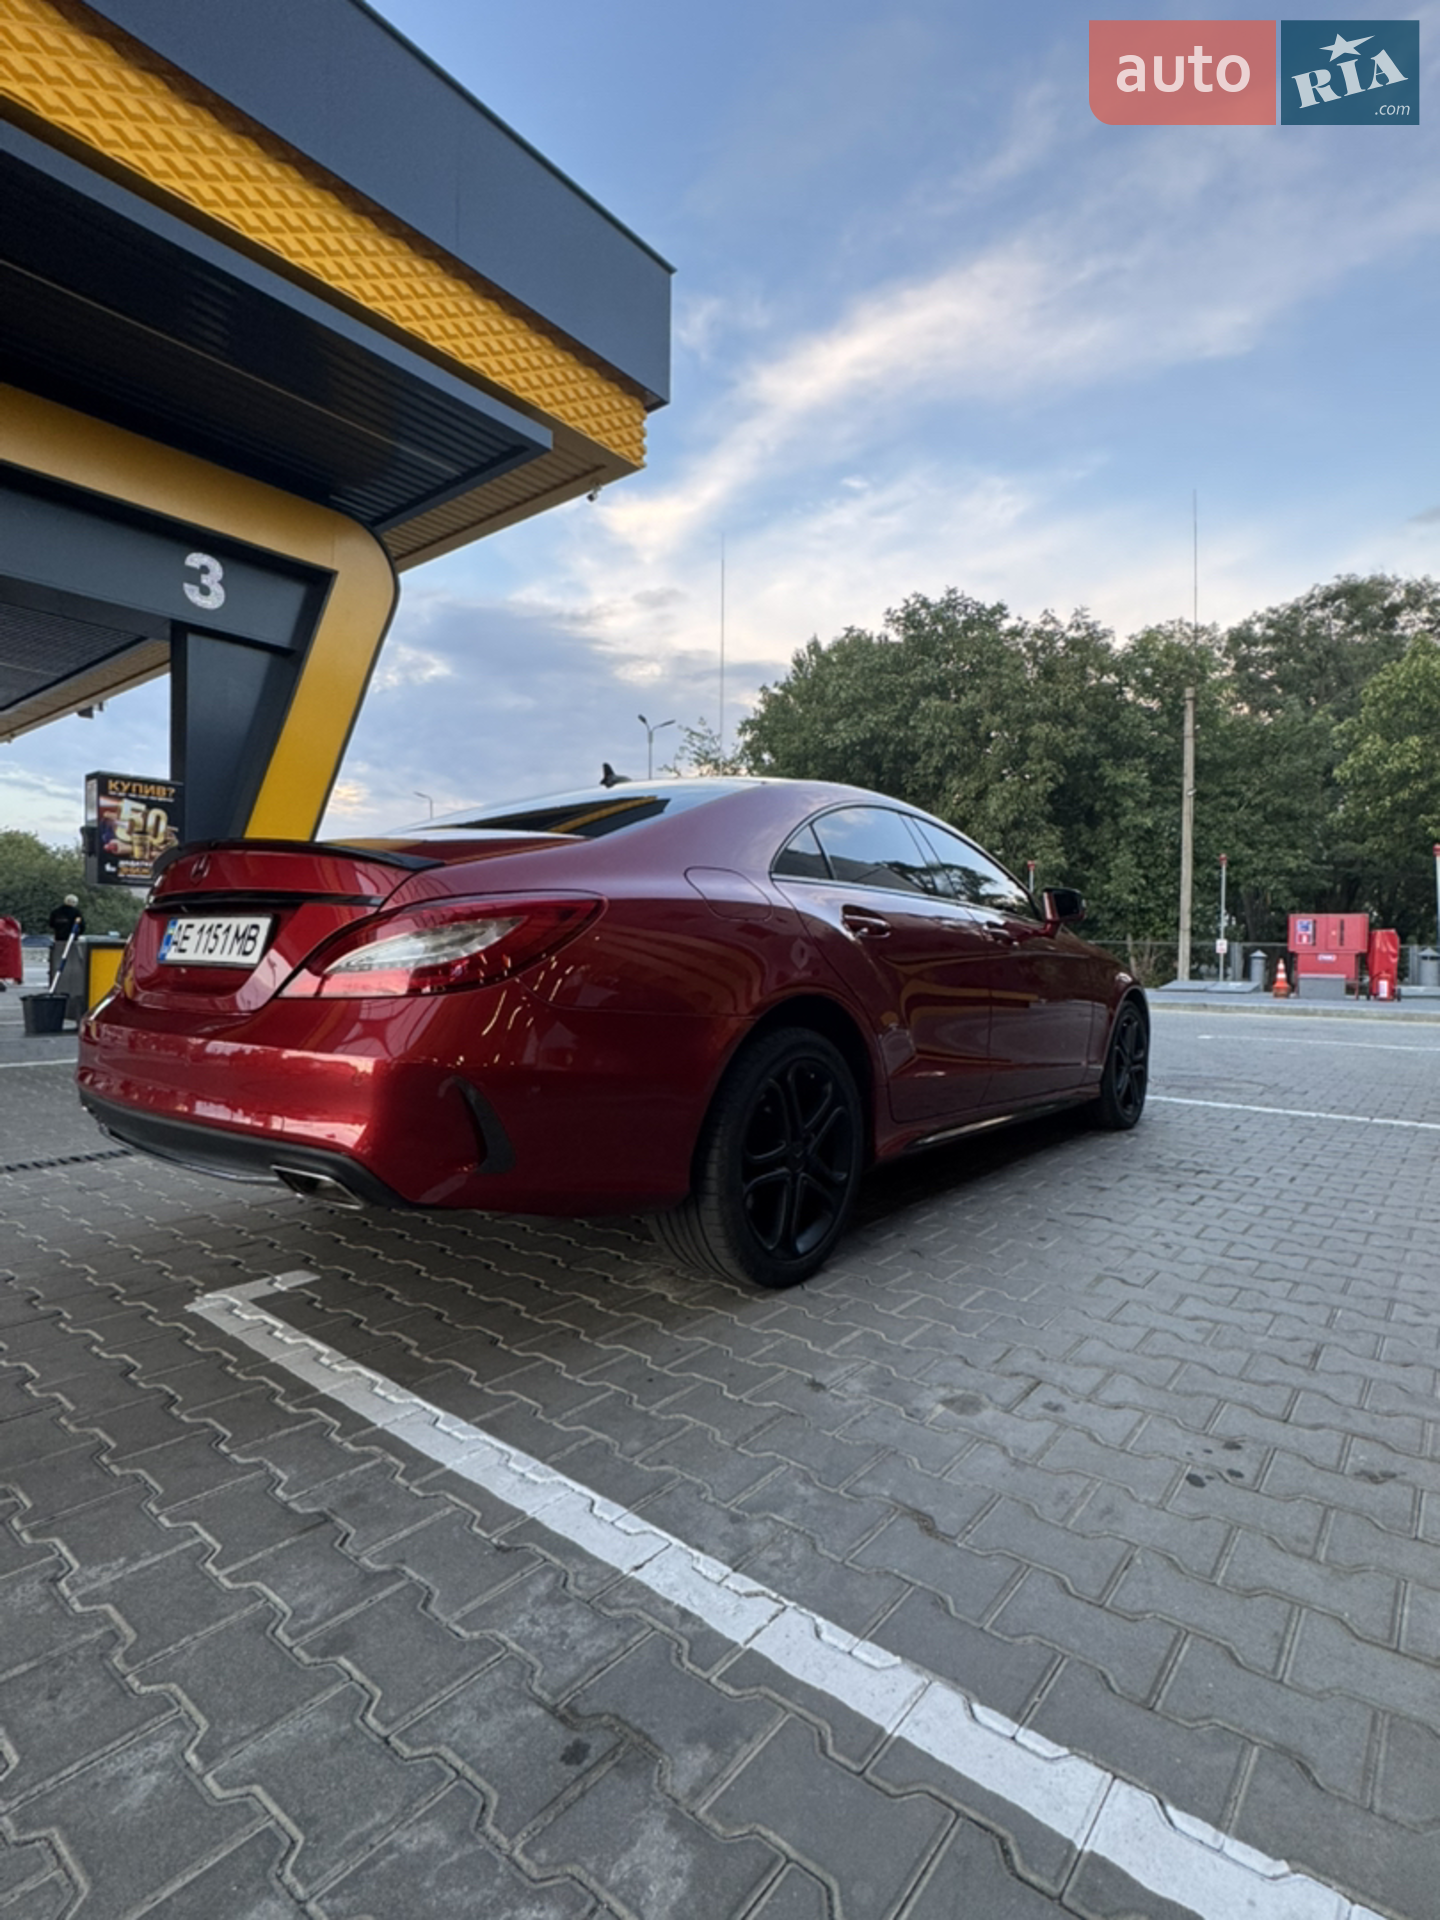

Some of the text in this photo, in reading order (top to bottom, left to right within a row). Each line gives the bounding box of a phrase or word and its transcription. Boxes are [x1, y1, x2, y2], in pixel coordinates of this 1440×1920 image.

[183, 552, 226, 610] 3
[108, 780, 176, 798] КУПИВ?
[115, 799, 168, 845] 50
